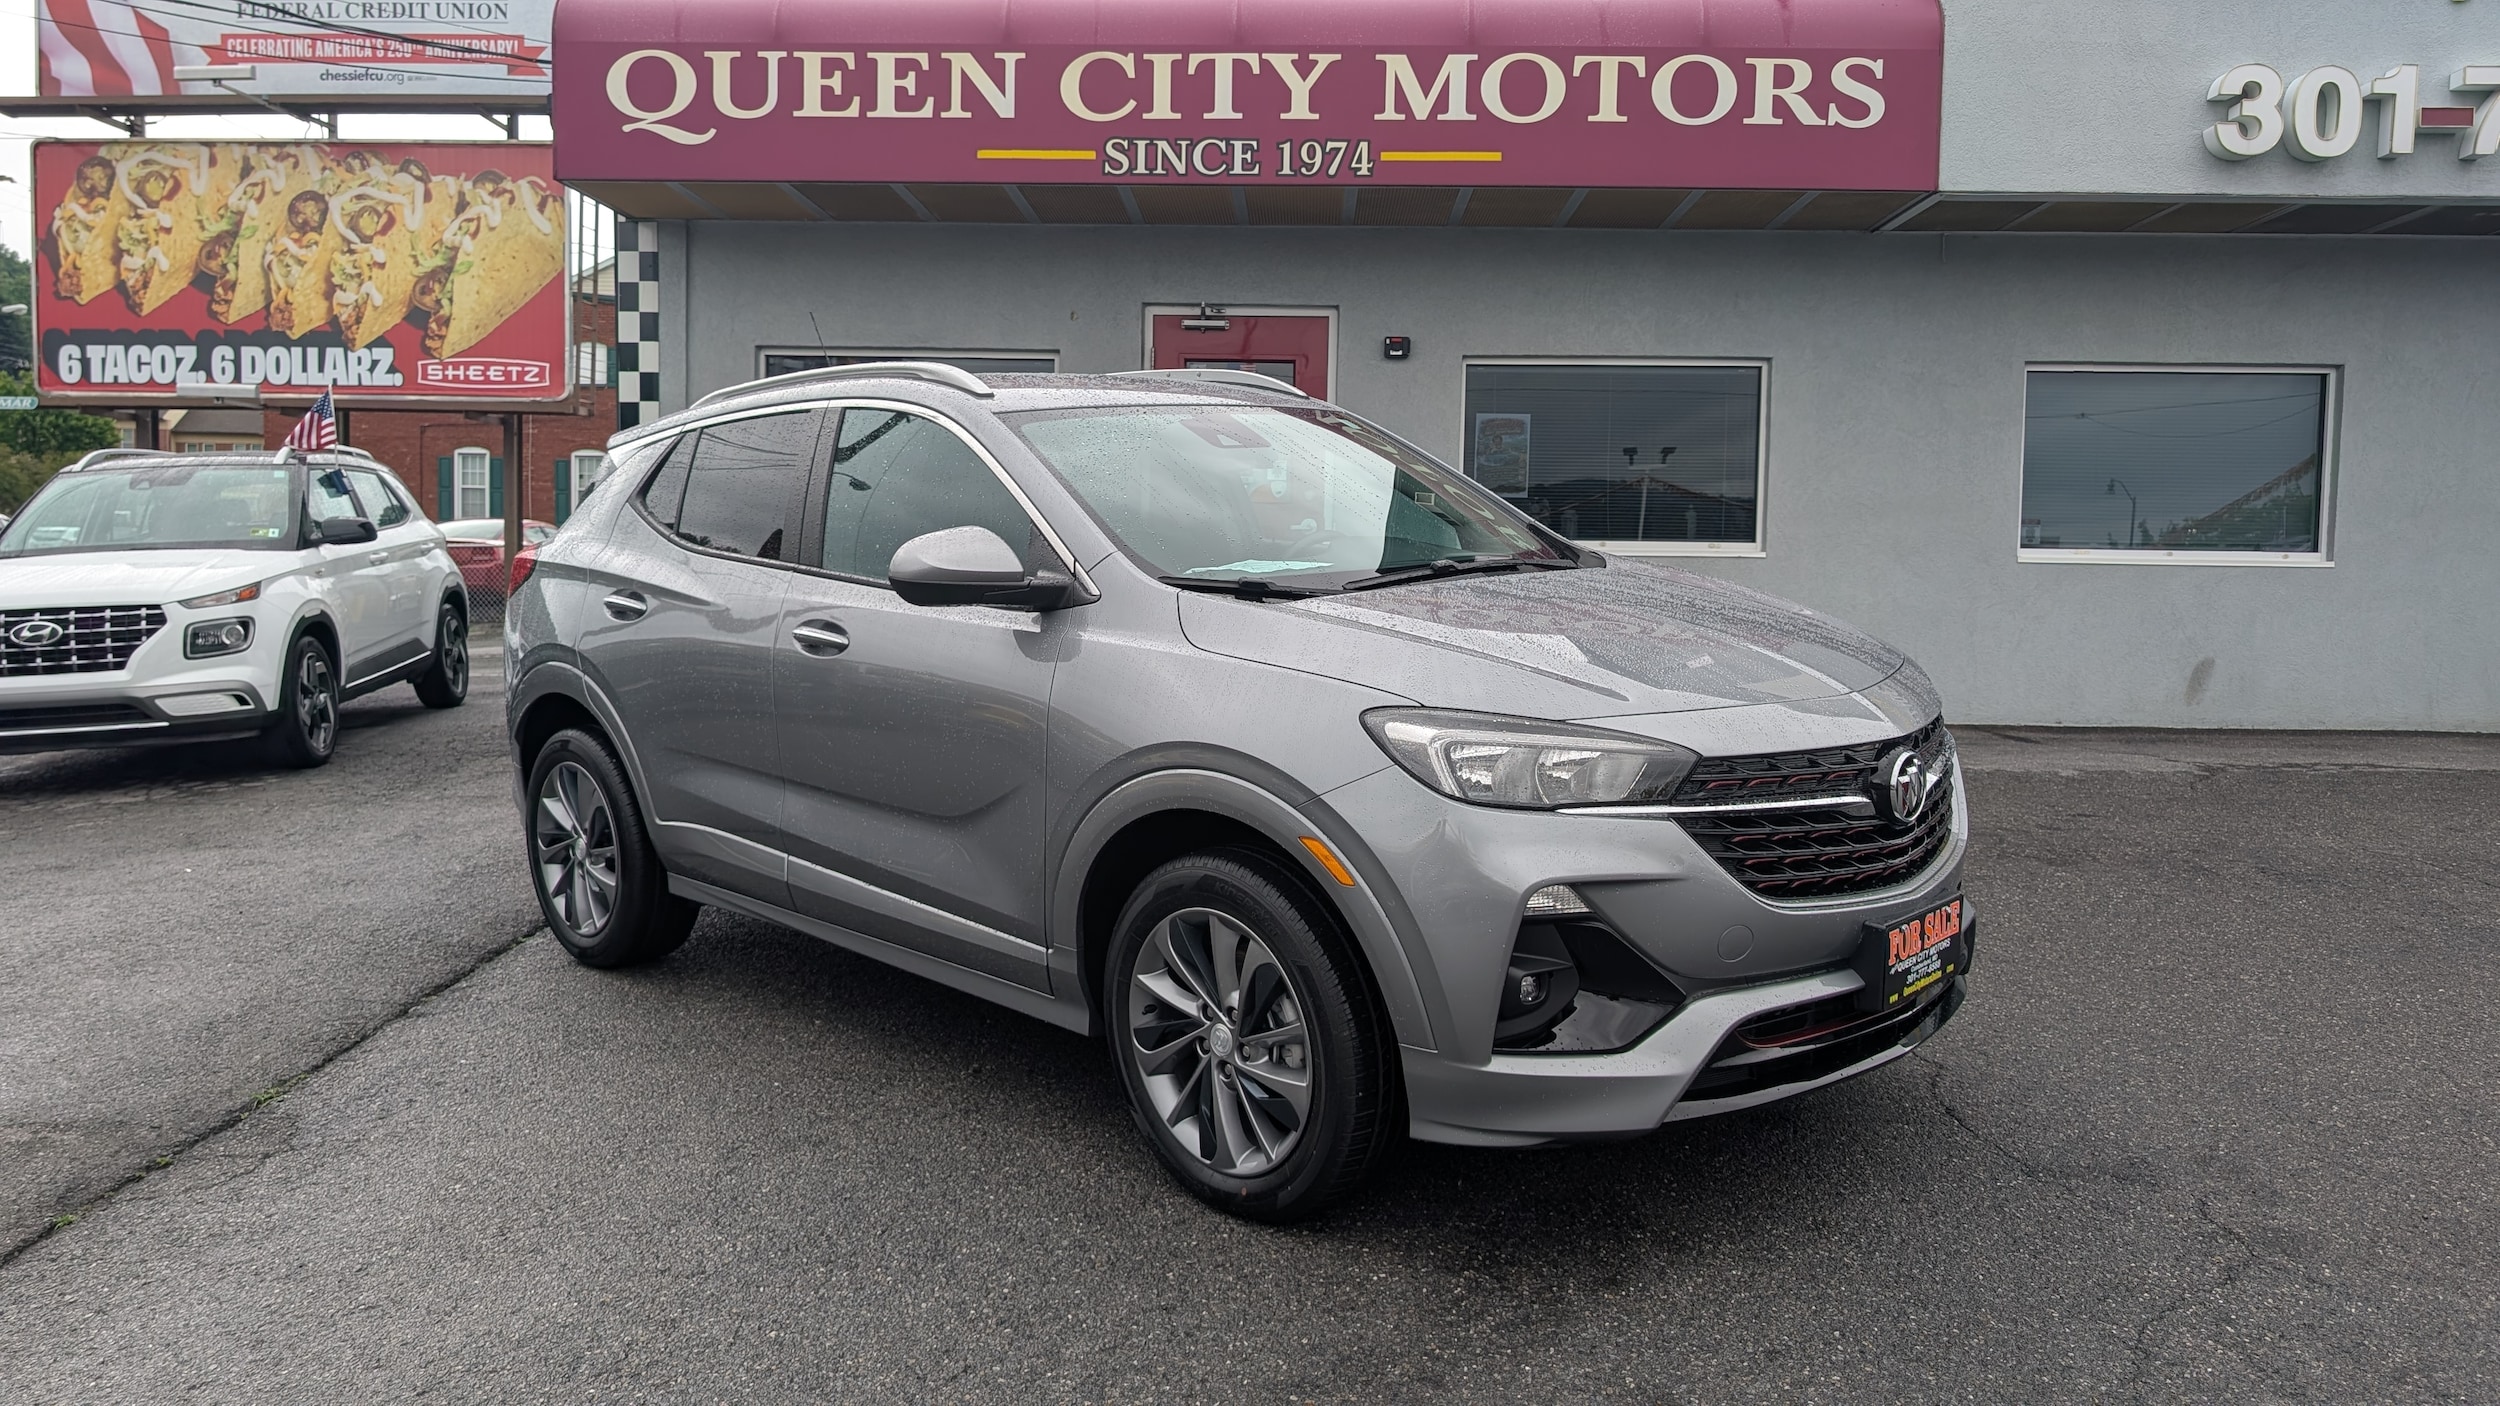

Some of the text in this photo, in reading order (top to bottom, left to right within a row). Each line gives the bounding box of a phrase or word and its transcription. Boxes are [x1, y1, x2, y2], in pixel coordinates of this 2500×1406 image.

[237, 1, 508, 19] FEDERAL CREDIT UNION
[227, 38, 313, 58] CELEBRATING
[315, 39, 384, 58] AMERICA'S
[425, 39, 519, 58] ANNIVERSARY!
[320, 68, 405, 85] chessiefcu.org
[605, 49, 1886, 145] QUEEN CITY MOTORS
[1102, 137, 1375, 179] SINCE 1974
[58, 344, 404, 387] 6 TACOZ. 6 DOLLARZ.
[427, 363, 541, 383] SHEETZ
[1889, 900, 1960, 966] FOR SALE
[1897, 955, 1917, 972] QUEEN
[1917, 948, 1930, 962] CITY
